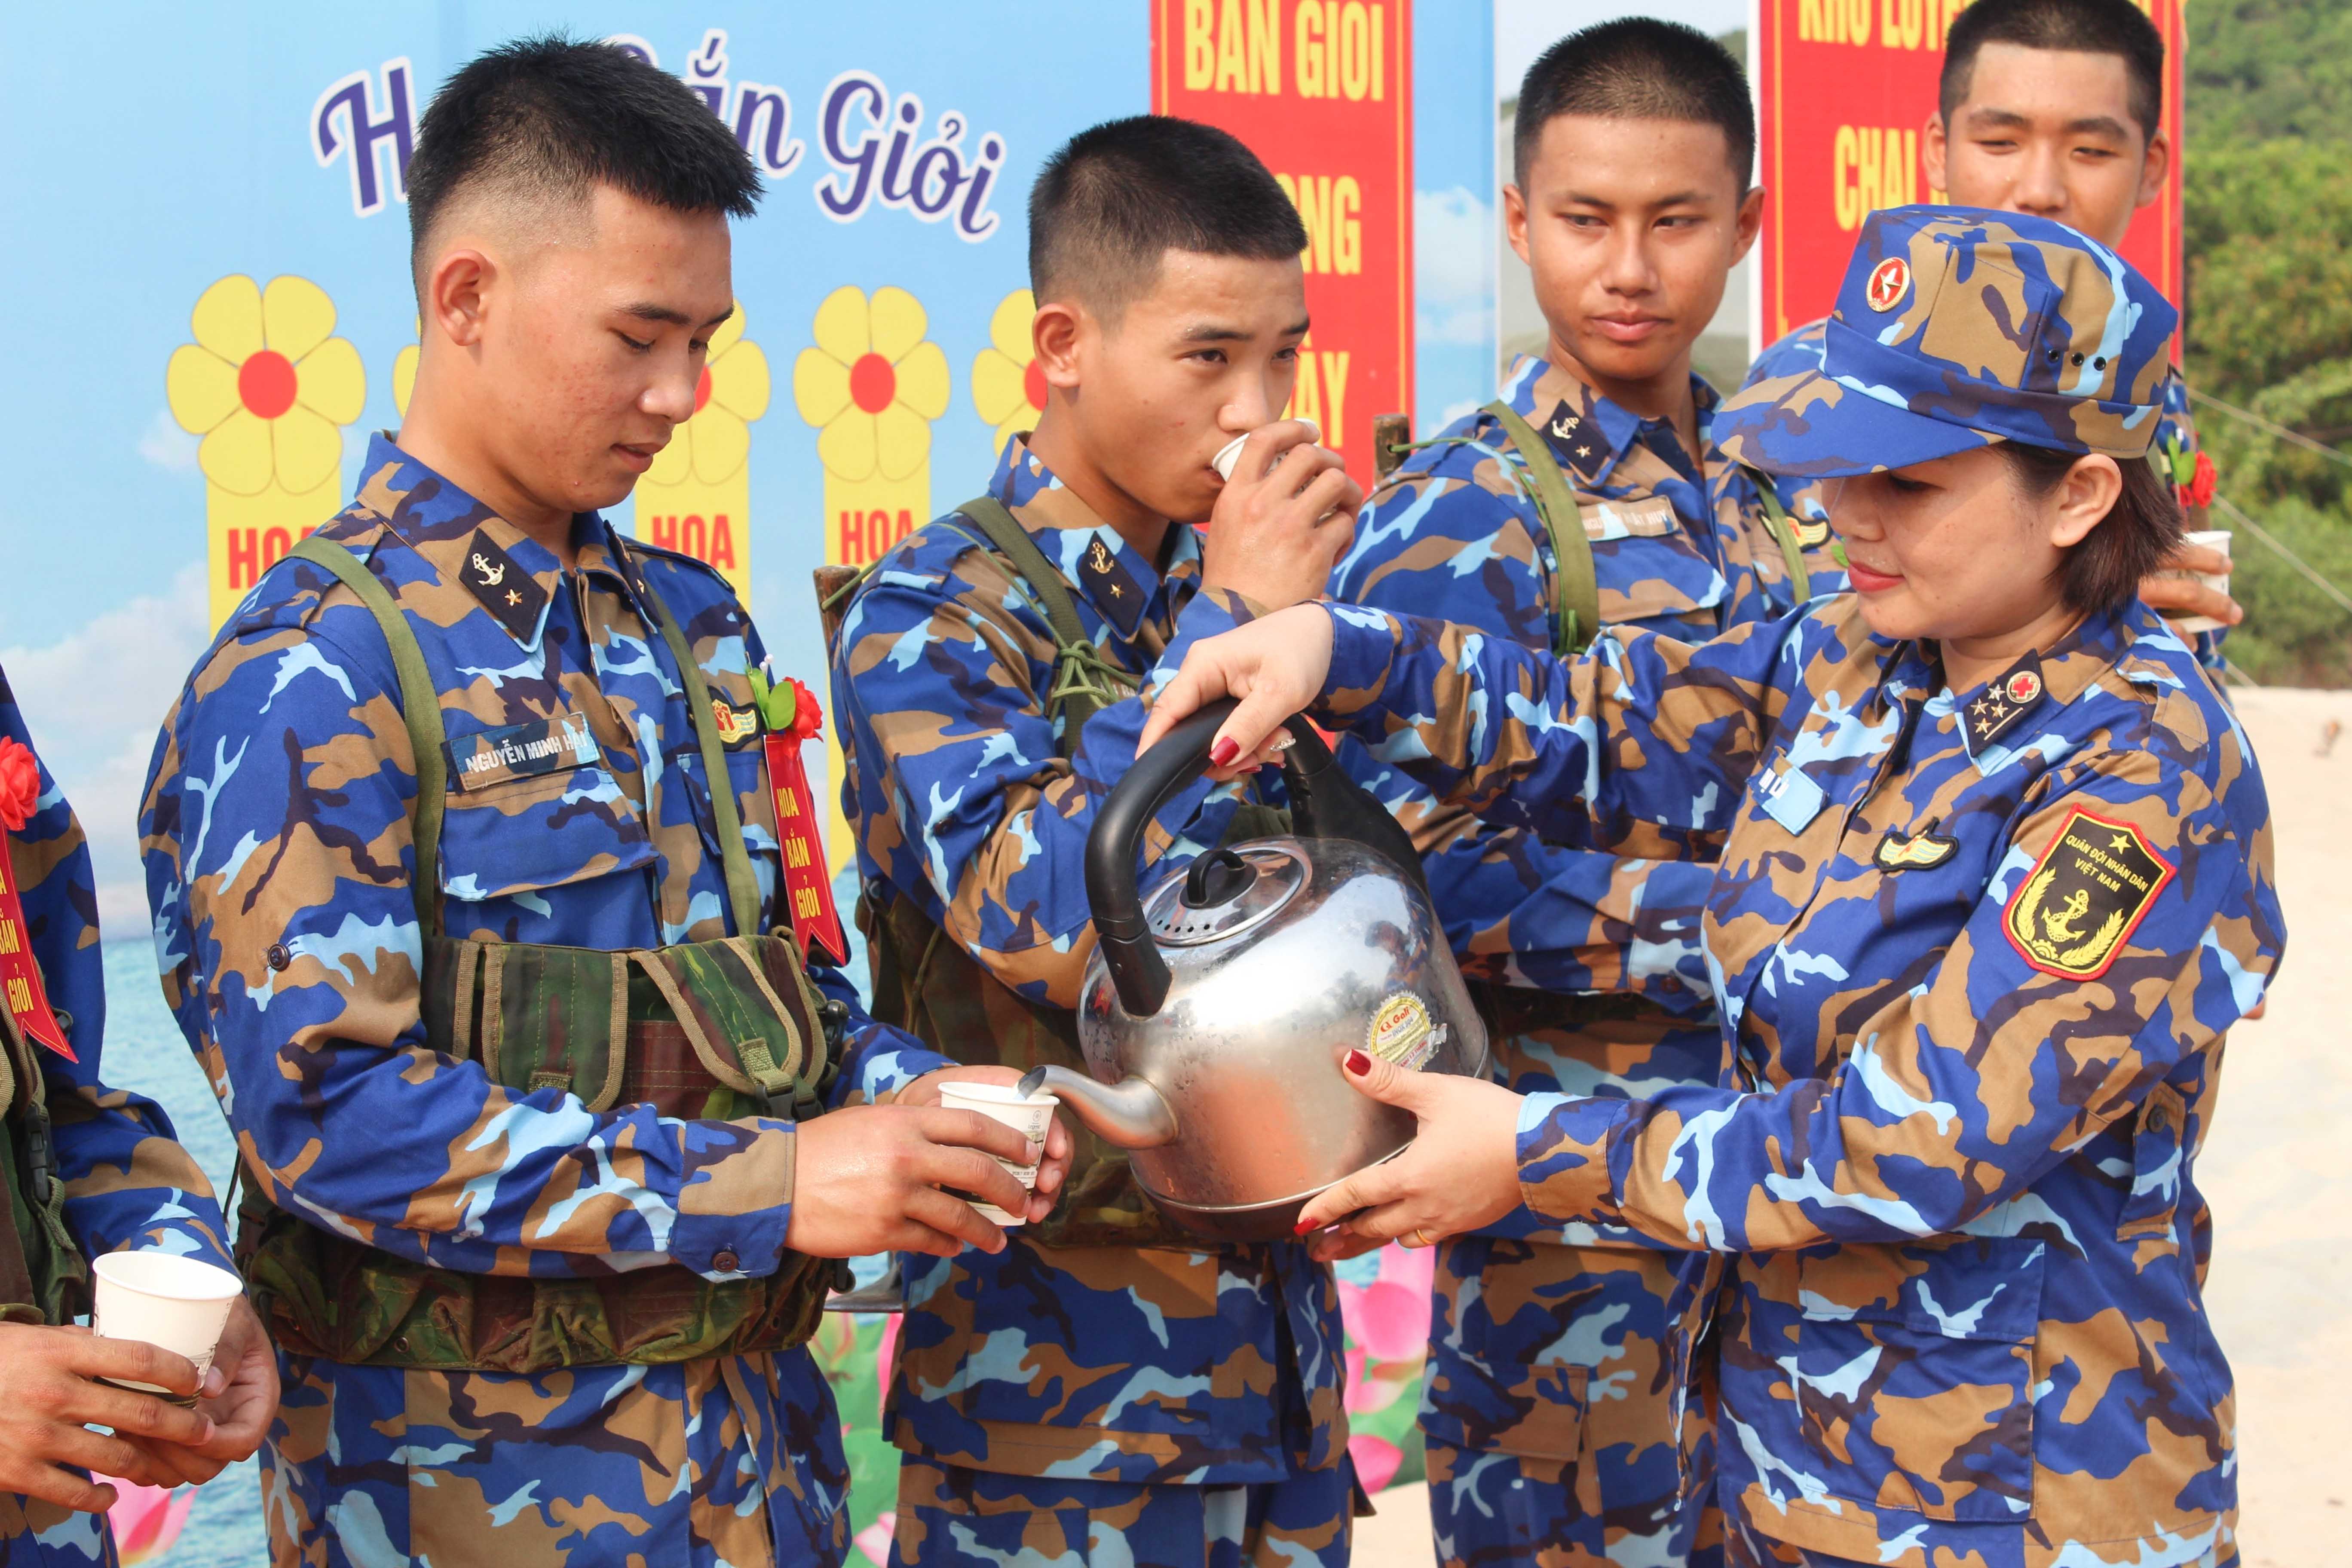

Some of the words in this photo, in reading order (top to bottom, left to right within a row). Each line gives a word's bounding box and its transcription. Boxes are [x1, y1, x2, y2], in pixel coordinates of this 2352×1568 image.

[819, 79, 998, 235] Giỏi
[228, 525, 316, 590] HO
[652, 514, 736, 570] HOA
[465, 738, 526, 774] NGUYỄN
[525, 736, 563, 760] MINH
[777, 787, 800, 818] HOA
[785, 828, 811, 868] BẮN
[2066, 835, 2090, 854] QUÂN
[2090, 848, 2108, 864] ĐỘI
[2105, 859, 2131, 879] NHÂN
[2129, 874, 2148, 892] DÂN
[796, 875, 821, 919] GIỎI
[2075, 858, 2098, 877] VIỆT
[2097, 873, 2121, 892] NAM
[7, 962, 34, 1014] GIỎI
[1393, 1006, 1409, 1023] Gali
